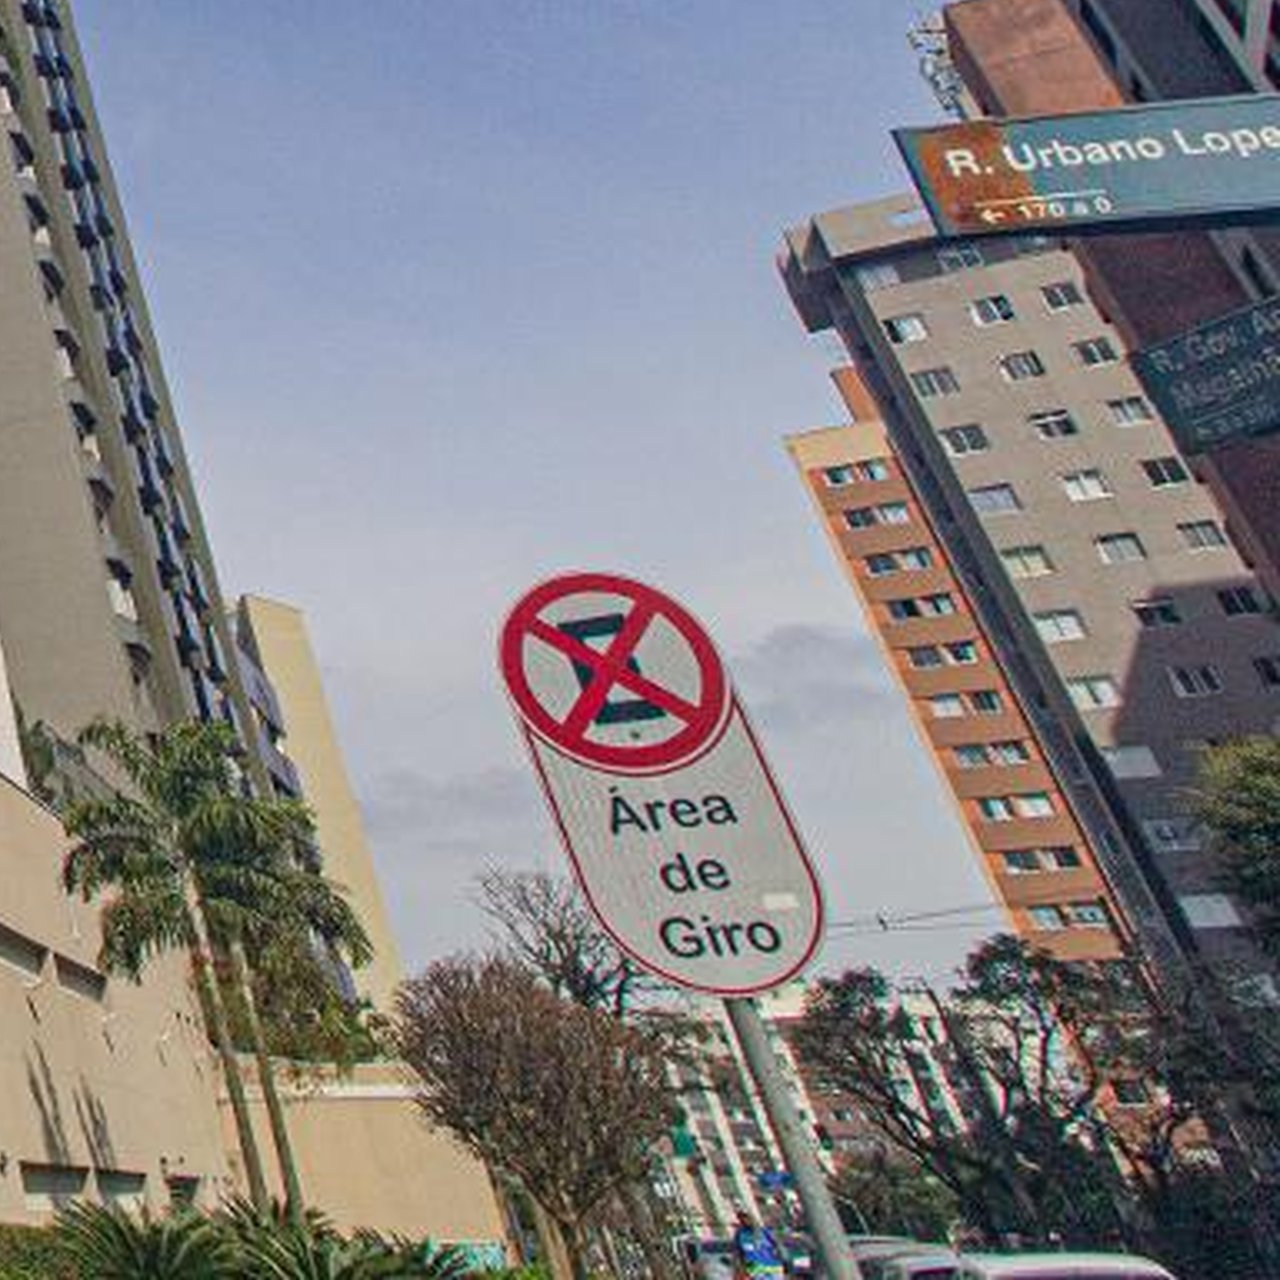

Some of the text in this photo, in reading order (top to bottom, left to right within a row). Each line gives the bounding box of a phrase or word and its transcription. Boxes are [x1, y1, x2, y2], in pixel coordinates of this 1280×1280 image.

[944, 148, 993, 178] R.
[1003, 136, 1165, 171] Urbano
[1018, 202, 1062, 220] 170
[609, 785, 739, 836] Área
[659, 852, 732, 894] de
[658, 914, 782, 959] Giro
